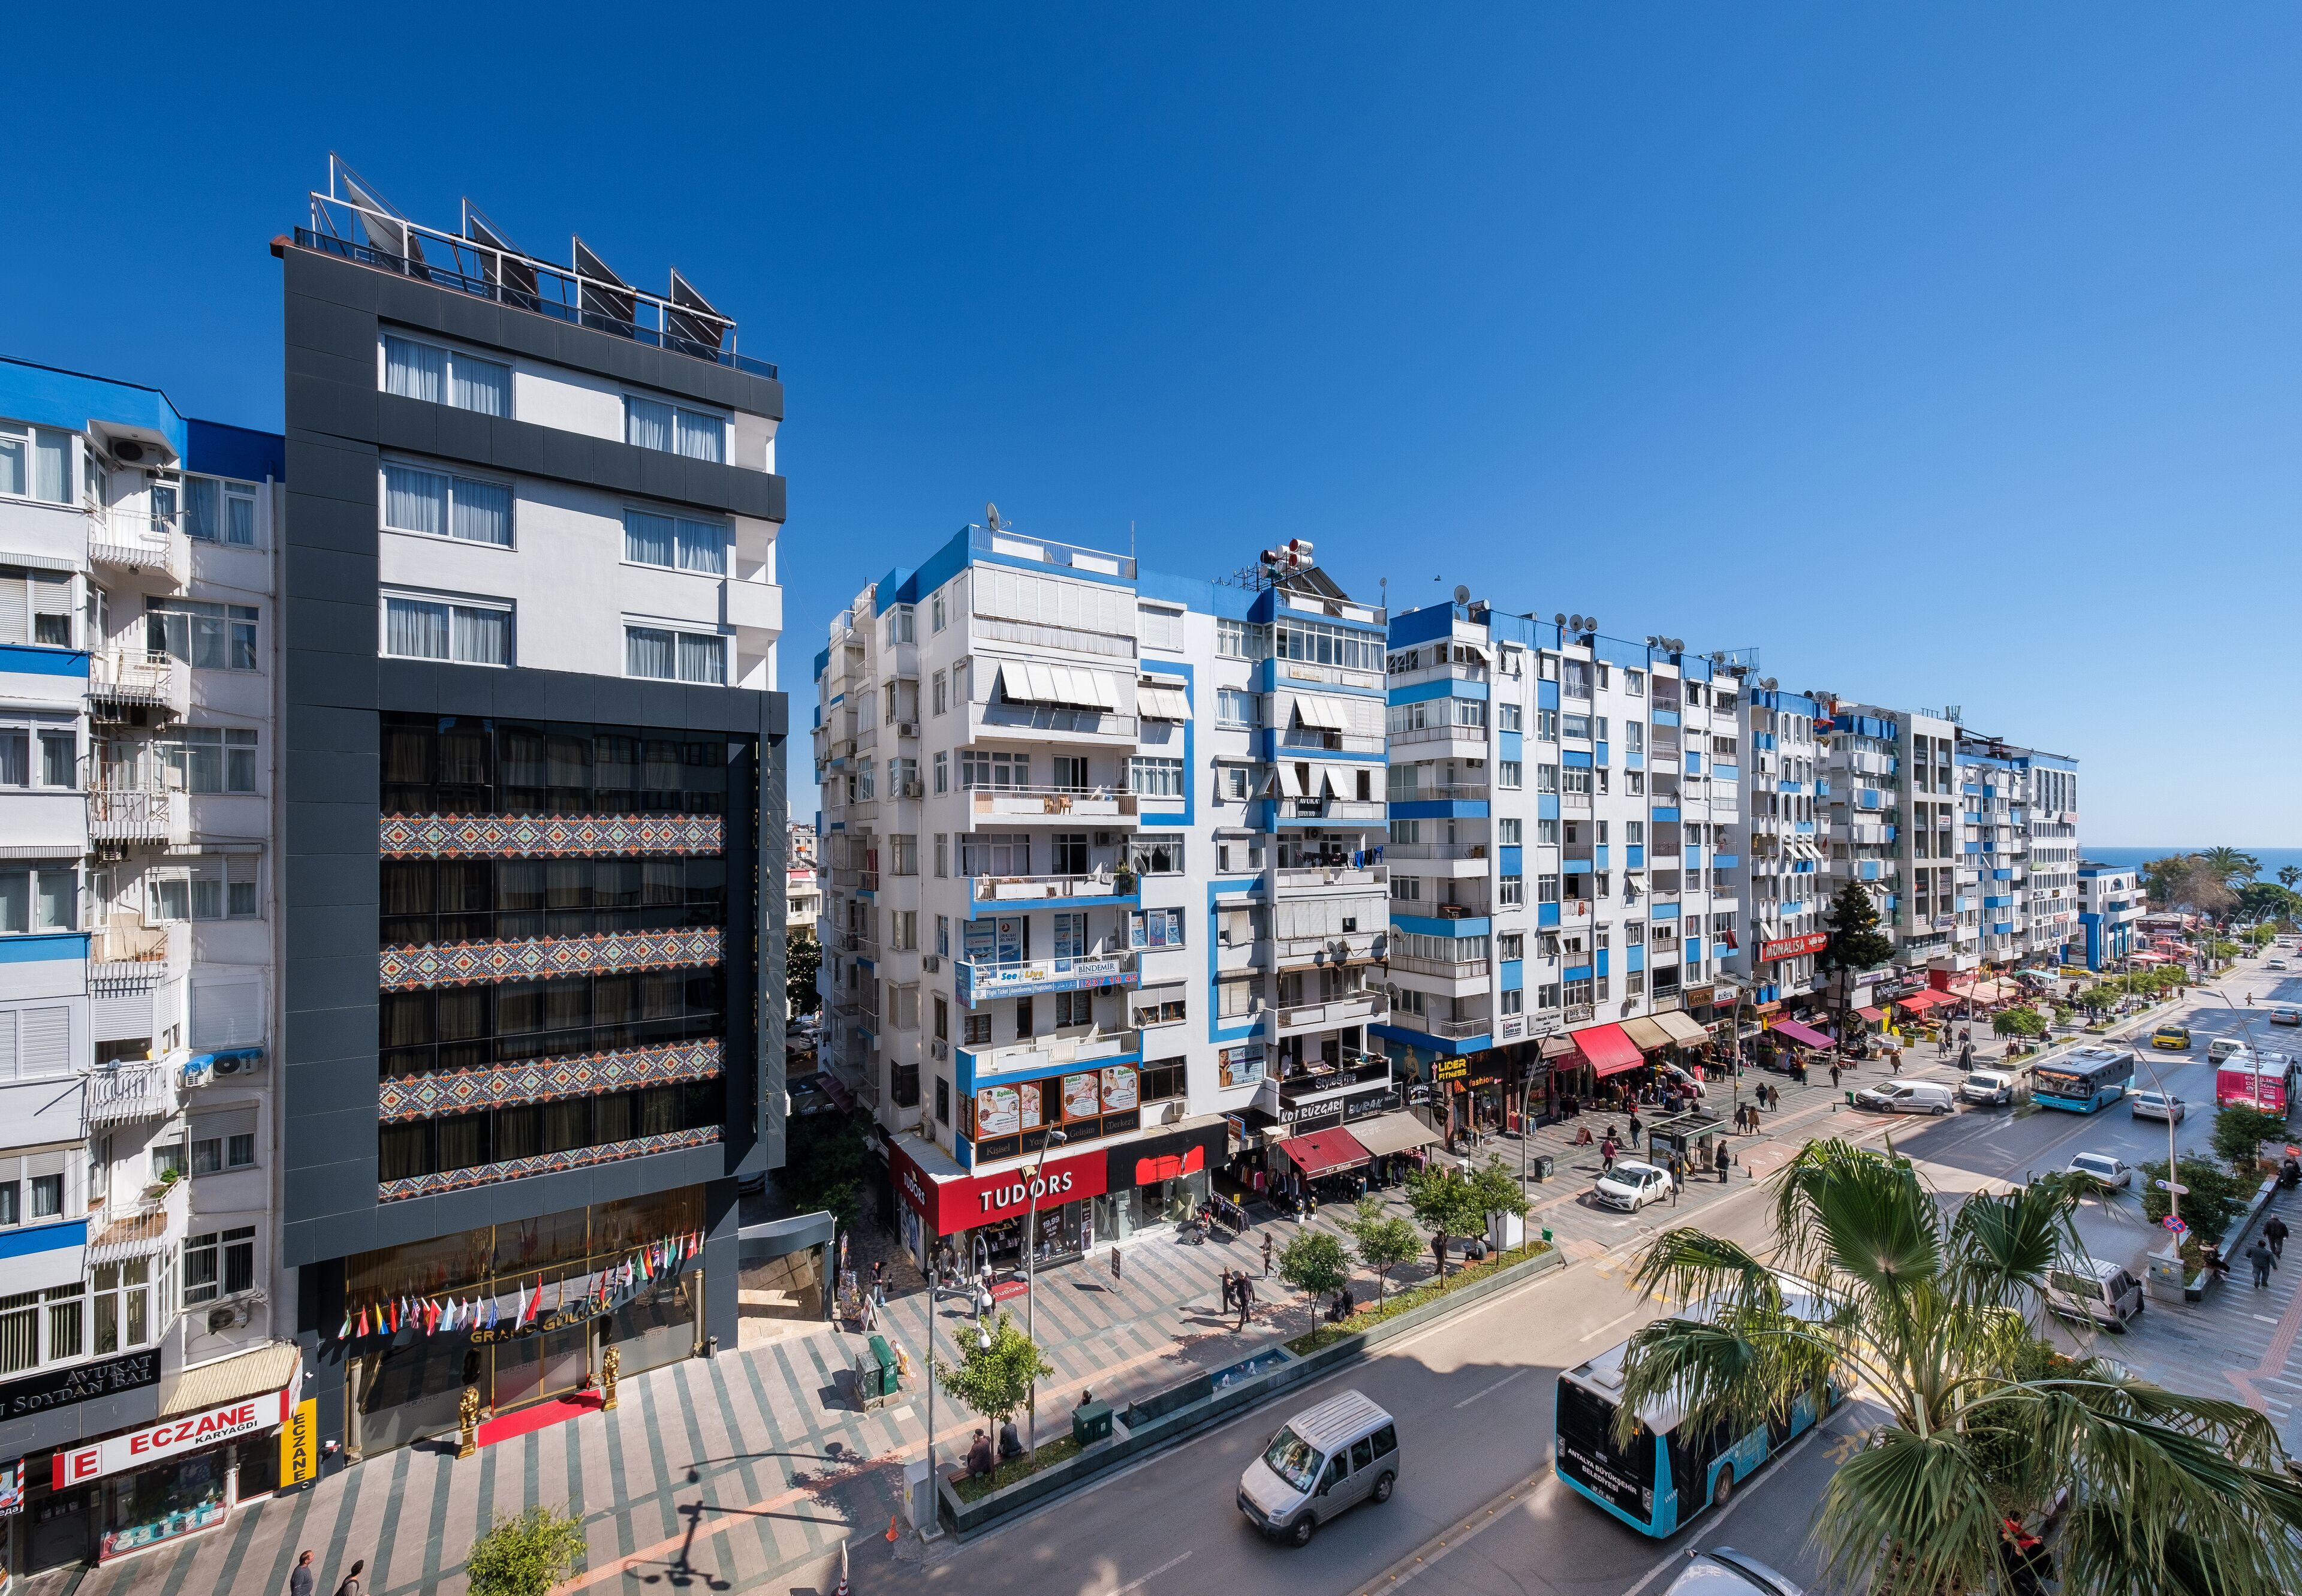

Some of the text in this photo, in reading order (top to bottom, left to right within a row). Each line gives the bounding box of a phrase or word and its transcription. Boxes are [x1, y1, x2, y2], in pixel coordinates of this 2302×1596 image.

[1025, 969, 1044, 978] Live
[1085, 978, 1105, 986] 237
[1410, 1084, 1429, 1095] ANTALYA
[1348, 1098, 1383, 1115] BURAK
[1409, 1096, 1430, 1106] TAVERNA
[1301, 1098, 1343, 1119] RÜZGARI
[1106, 1118, 1134, 1131] Merkezi
[1070, 1127, 1095, 1138] Gelişim
[986, 1142, 1010, 1156] Kişisel
[903, 1172, 926, 1206] TUDORS
[981, 1172, 1072, 1212] TUDORS
[993, 1285, 1024, 1297] TUDORS
[635, 1331, 662, 1342] GRAND
[550, 1349, 580, 1361] GRAND
[64, 1356, 152, 1386] AVUKAT
[503, 1362, 534, 1374] GRAND
[13, 1380, 104, 1413] SOYDAN
[111, 1369, 152, 1389] BAL
[405, 1395, 439, 1408] GRAND
[195, 1420, 258, 1444] KARYAĞDI
[75, 1403, 255, 1479] E ECZANE
[293, 1413, 306, 1482] ECZANE
[1568, 1448, 1637, 1495] ANTALYA BÜYÜKŞEHİR
[1582, 1465, 1619, 1493] BELEDİYESİ
